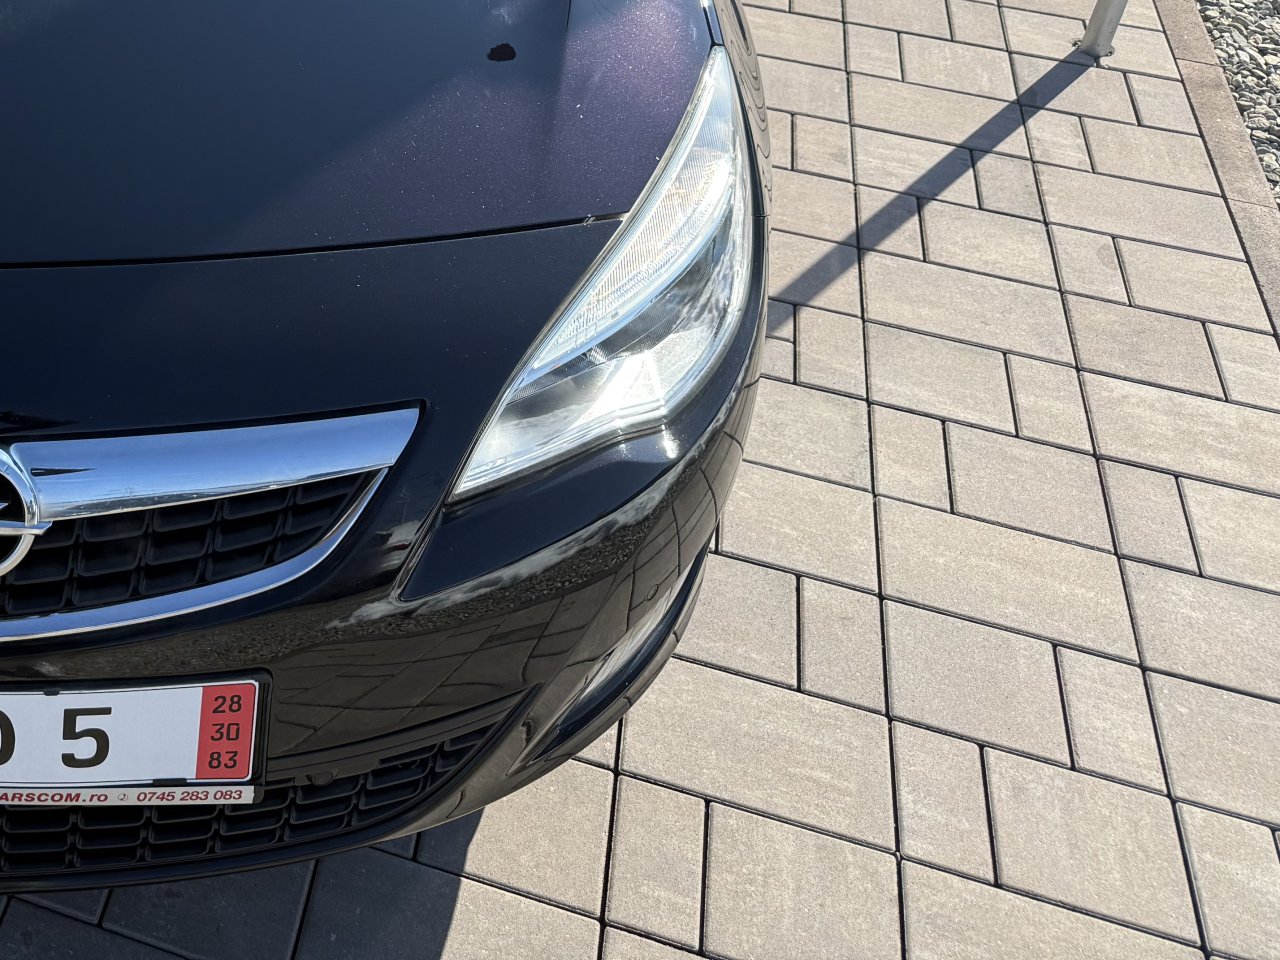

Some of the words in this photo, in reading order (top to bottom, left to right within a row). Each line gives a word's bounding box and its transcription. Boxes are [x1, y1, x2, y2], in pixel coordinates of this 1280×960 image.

[212, 694, 243, 714] 28
[61, 707, 113, 769] 5
[210, 722, 241, 742] 30
[208, 750, 239, 769] 83
[136, 790, 176, 803] 0745
[179, 790, 209, 802] 283
[213, 789, 243, 802] 083
